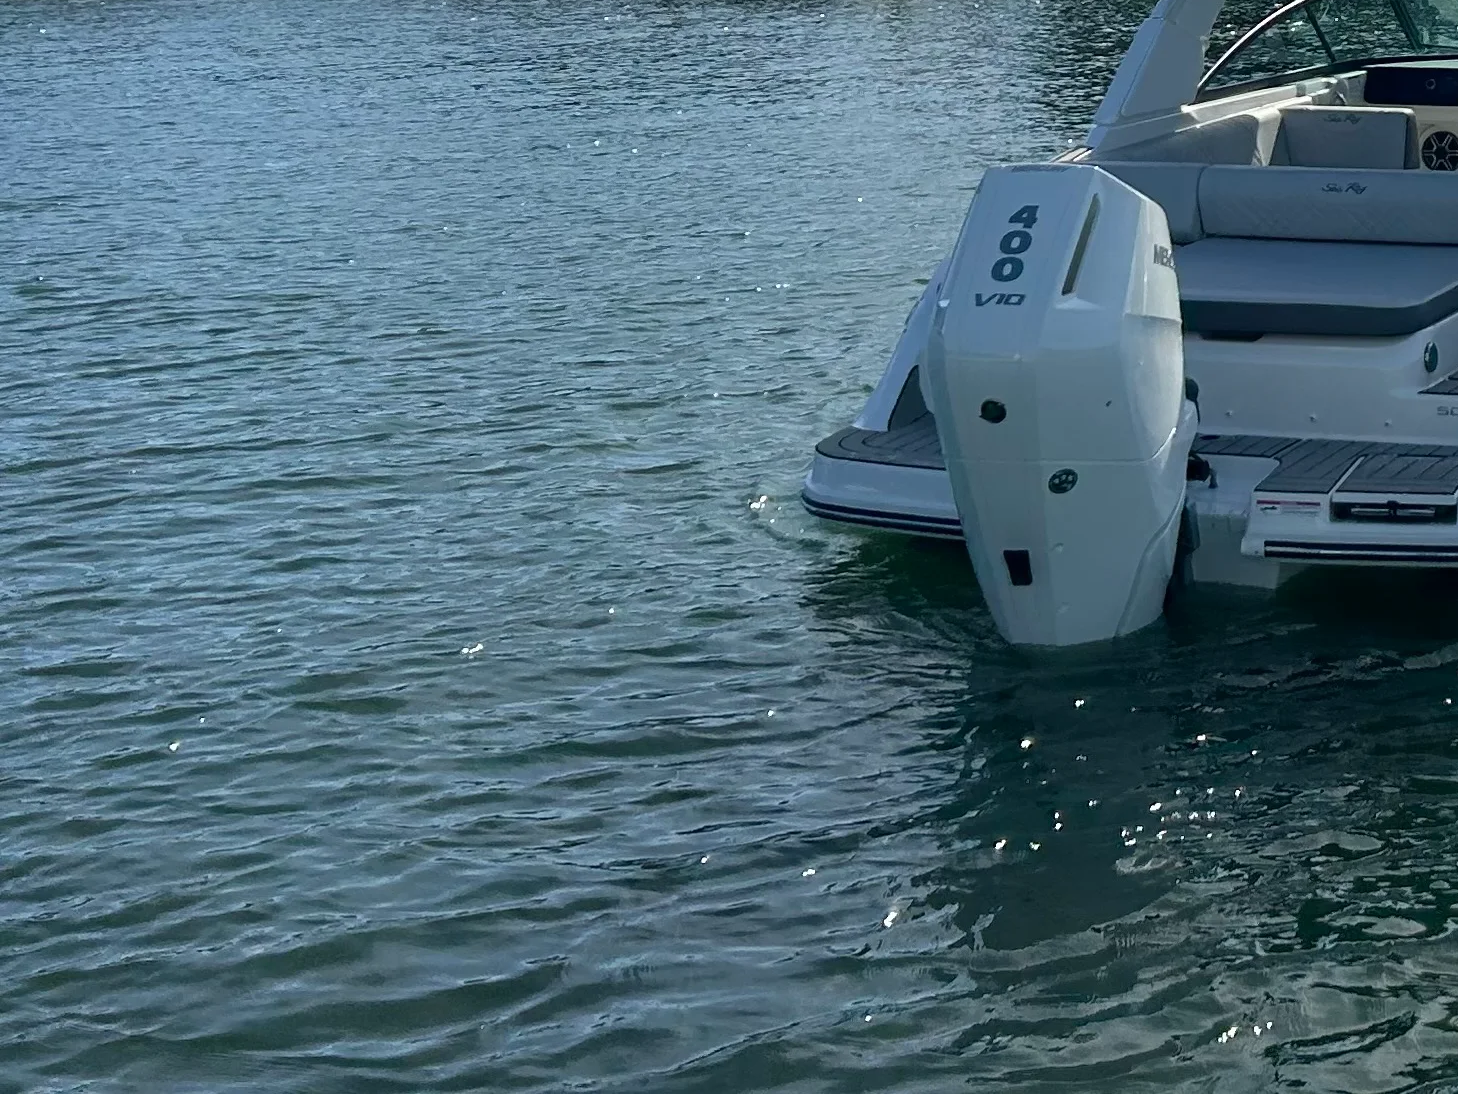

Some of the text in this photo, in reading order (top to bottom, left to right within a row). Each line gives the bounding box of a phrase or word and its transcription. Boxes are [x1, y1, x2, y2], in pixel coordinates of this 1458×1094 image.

[1321, 181, 1368, 195] Sea Ray
[991, 205, 1040, 283] 400
[975, 292, 1026, 306] V10
